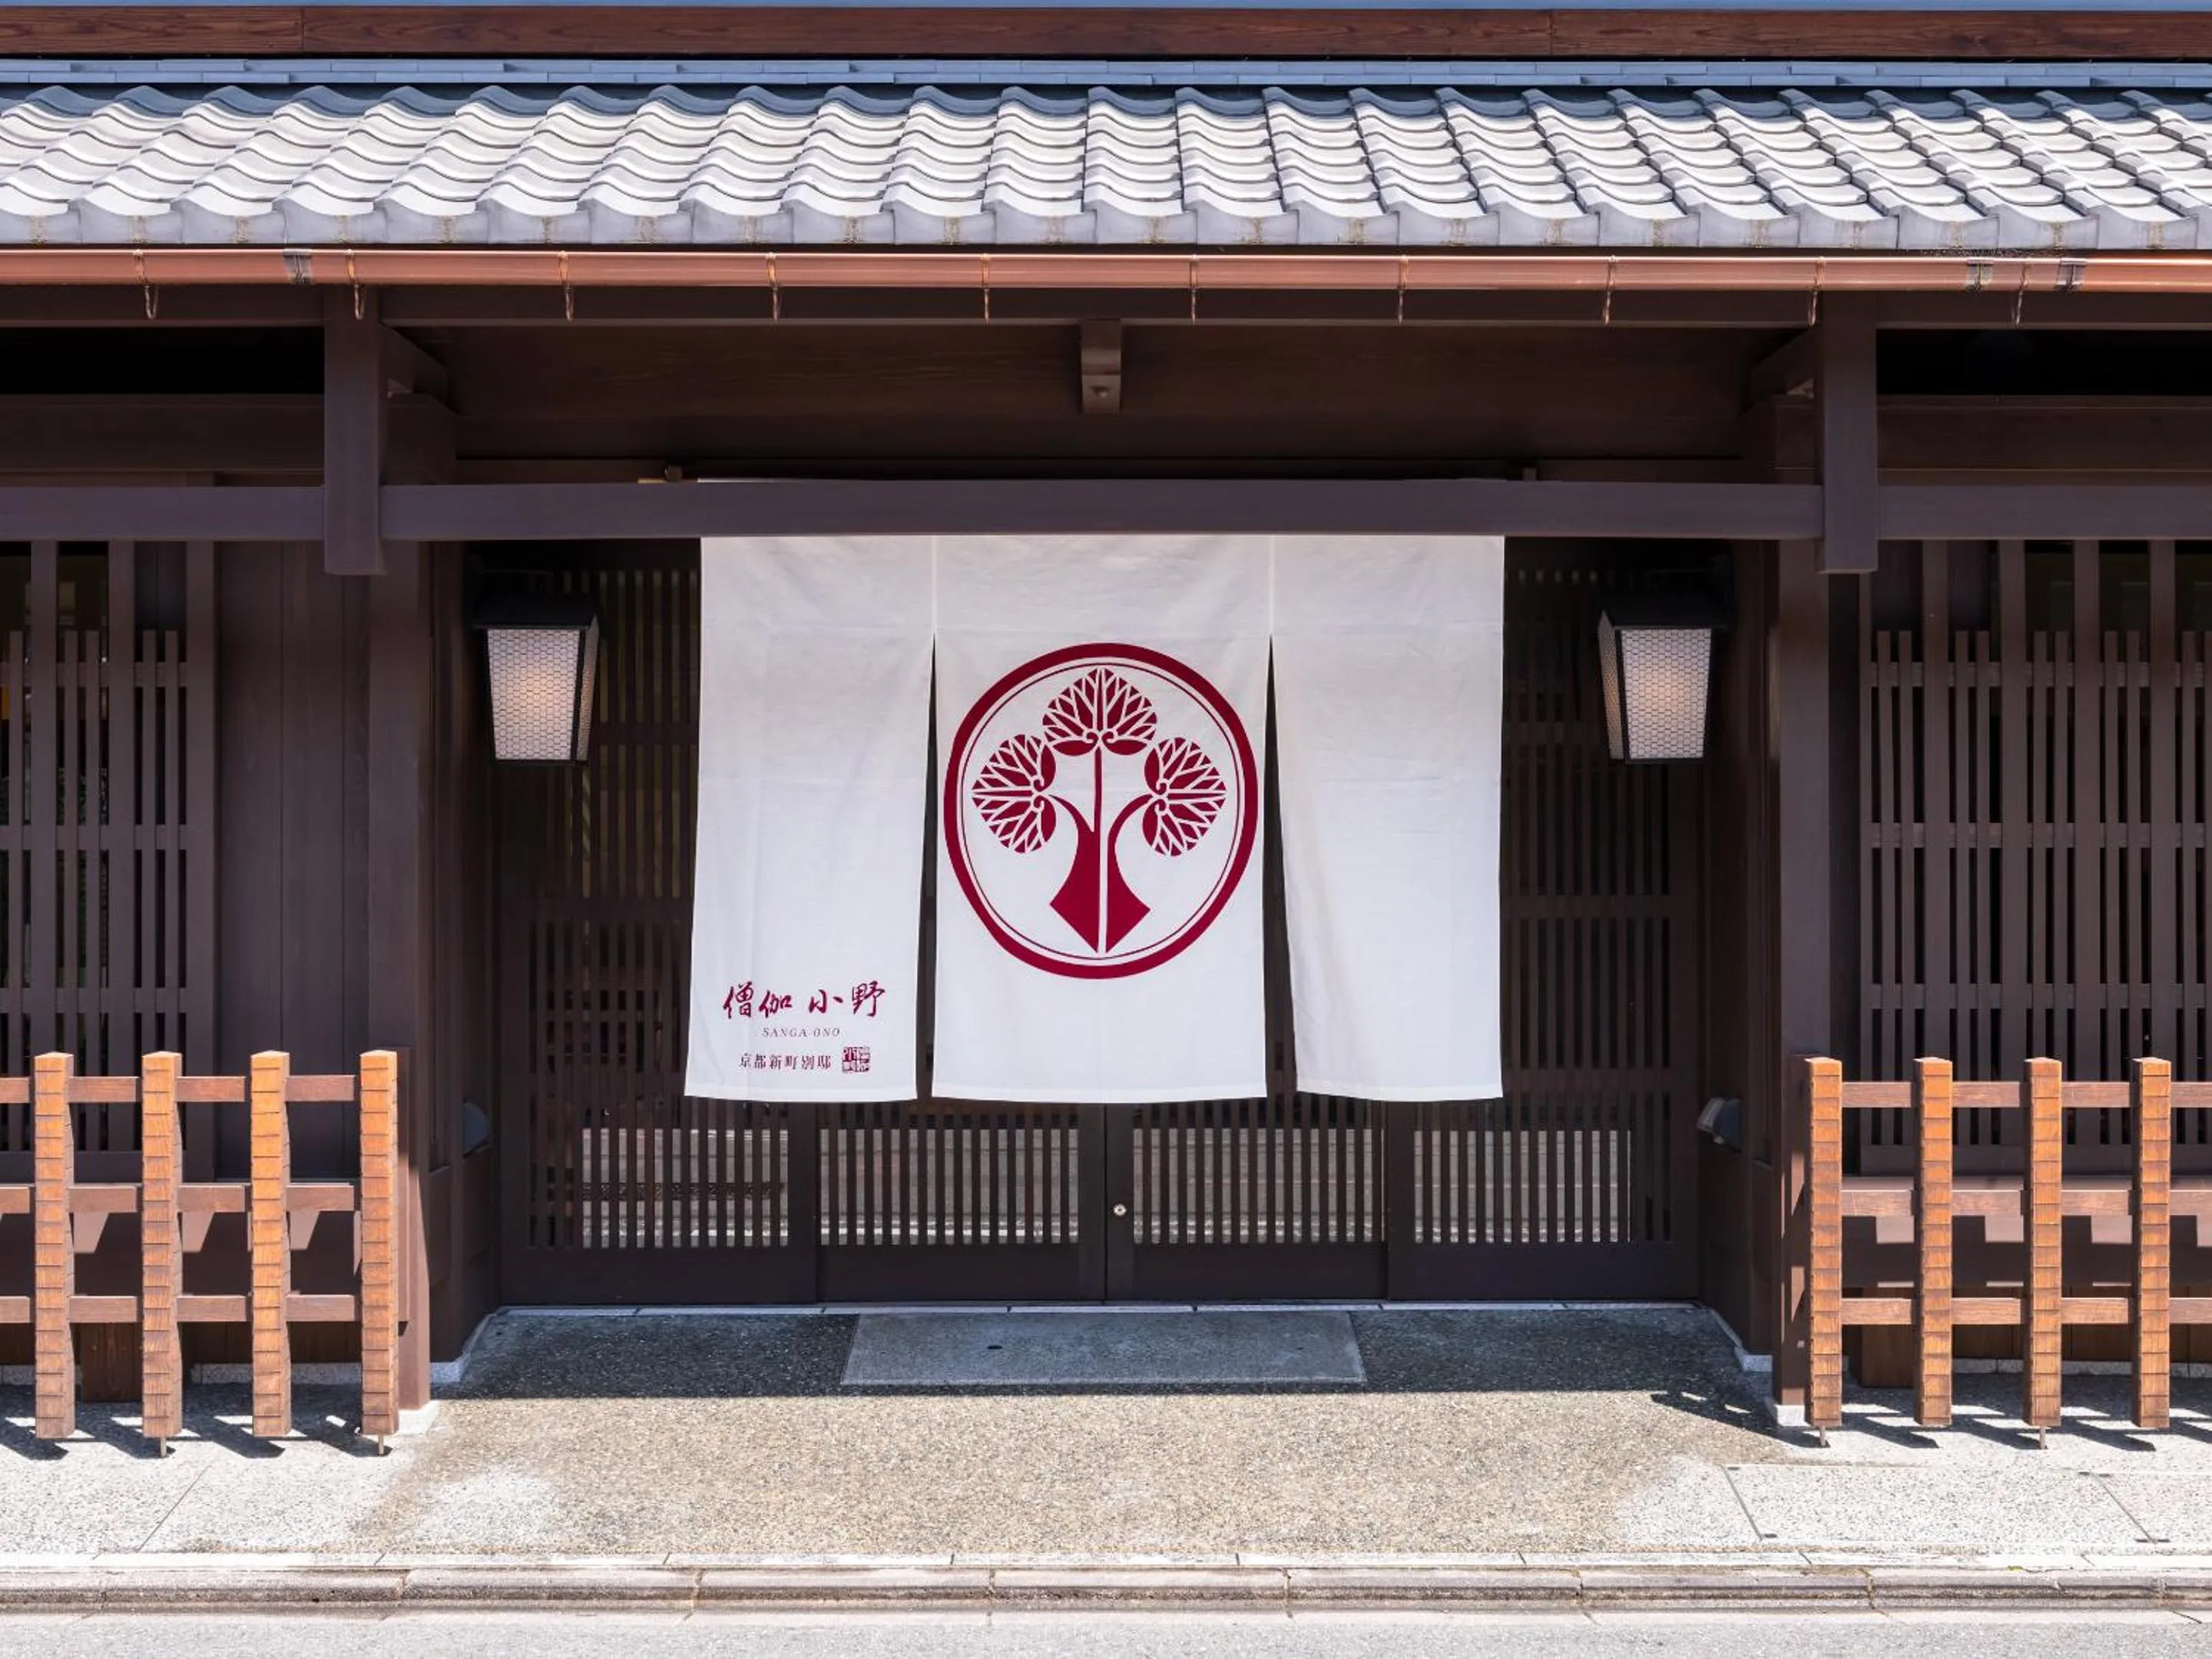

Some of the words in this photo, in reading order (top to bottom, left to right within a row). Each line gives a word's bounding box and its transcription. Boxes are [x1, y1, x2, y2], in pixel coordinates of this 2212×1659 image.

[761, 1027, 808, 1038] SANGA
[813, 1027, 840, 1038] ONO
[740, 1052, 831, 1071] 京都新町別邸
